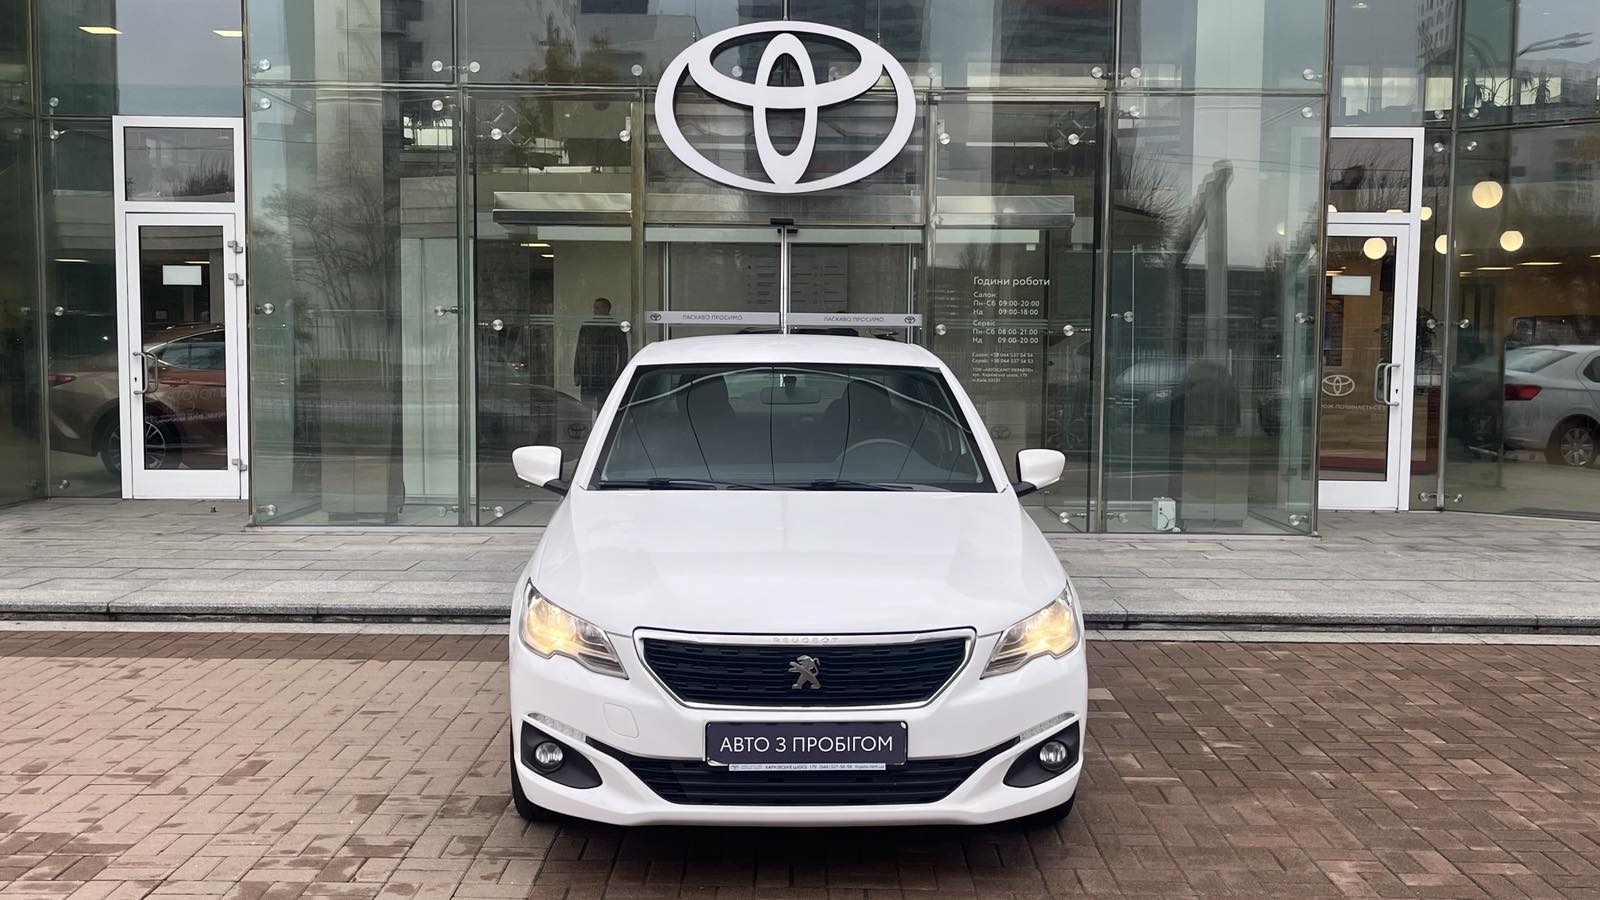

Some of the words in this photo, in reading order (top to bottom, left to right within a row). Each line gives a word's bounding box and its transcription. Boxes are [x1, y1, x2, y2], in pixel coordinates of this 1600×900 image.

[973, 276, 1010, 287] Години
[1012, 276, 1051, 288] роботи
[720, 737, 770, 752] АВТО
[775, 737, 787, 752] З
[793, 736, 893, 752] ПРОБІГОМ
